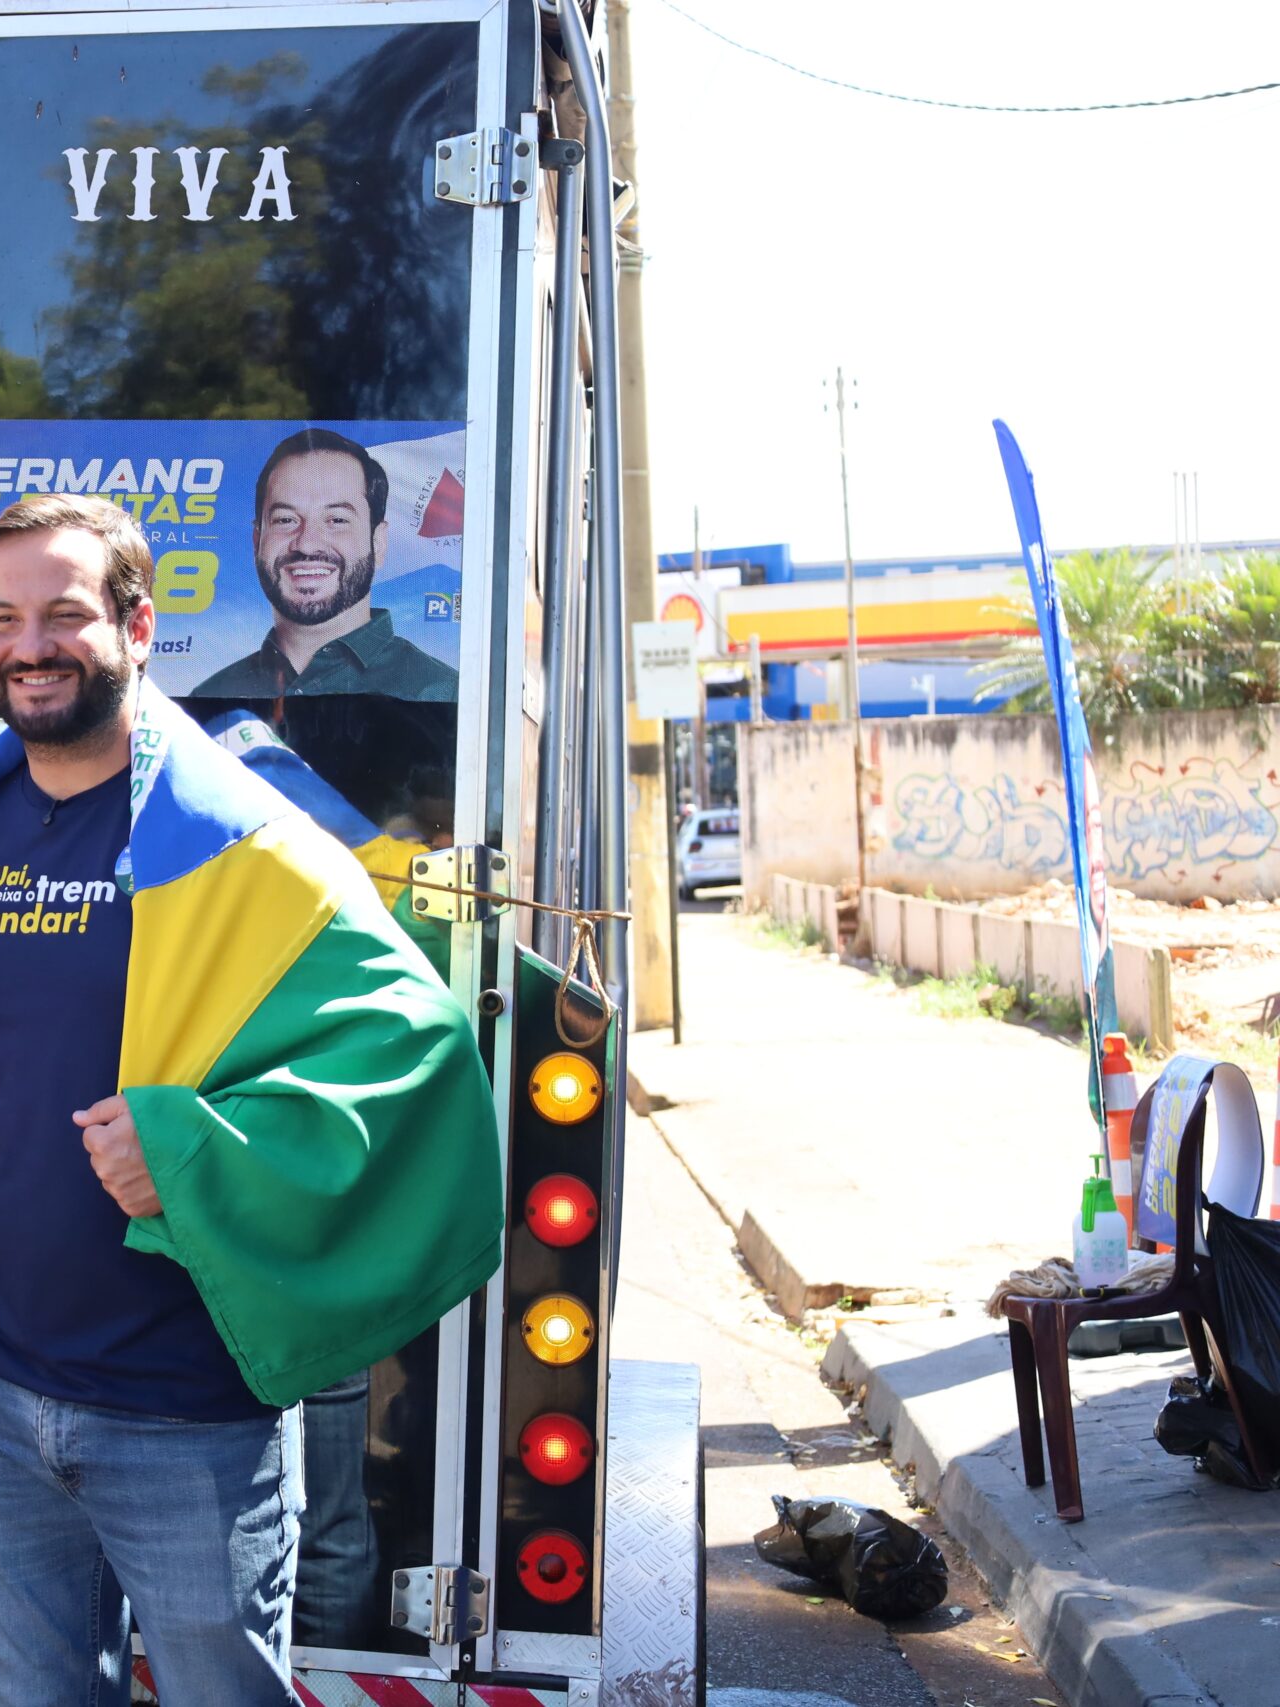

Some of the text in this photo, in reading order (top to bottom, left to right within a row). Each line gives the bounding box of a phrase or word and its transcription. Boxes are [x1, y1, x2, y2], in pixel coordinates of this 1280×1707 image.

[61, 146, 299, 222] VIVA
[410, 475, 437, 528] LIBERTAS
[428, 601, 447, 615] PL
[25, 891, 35, 902] o
[36, 875, 116, 903] trem
